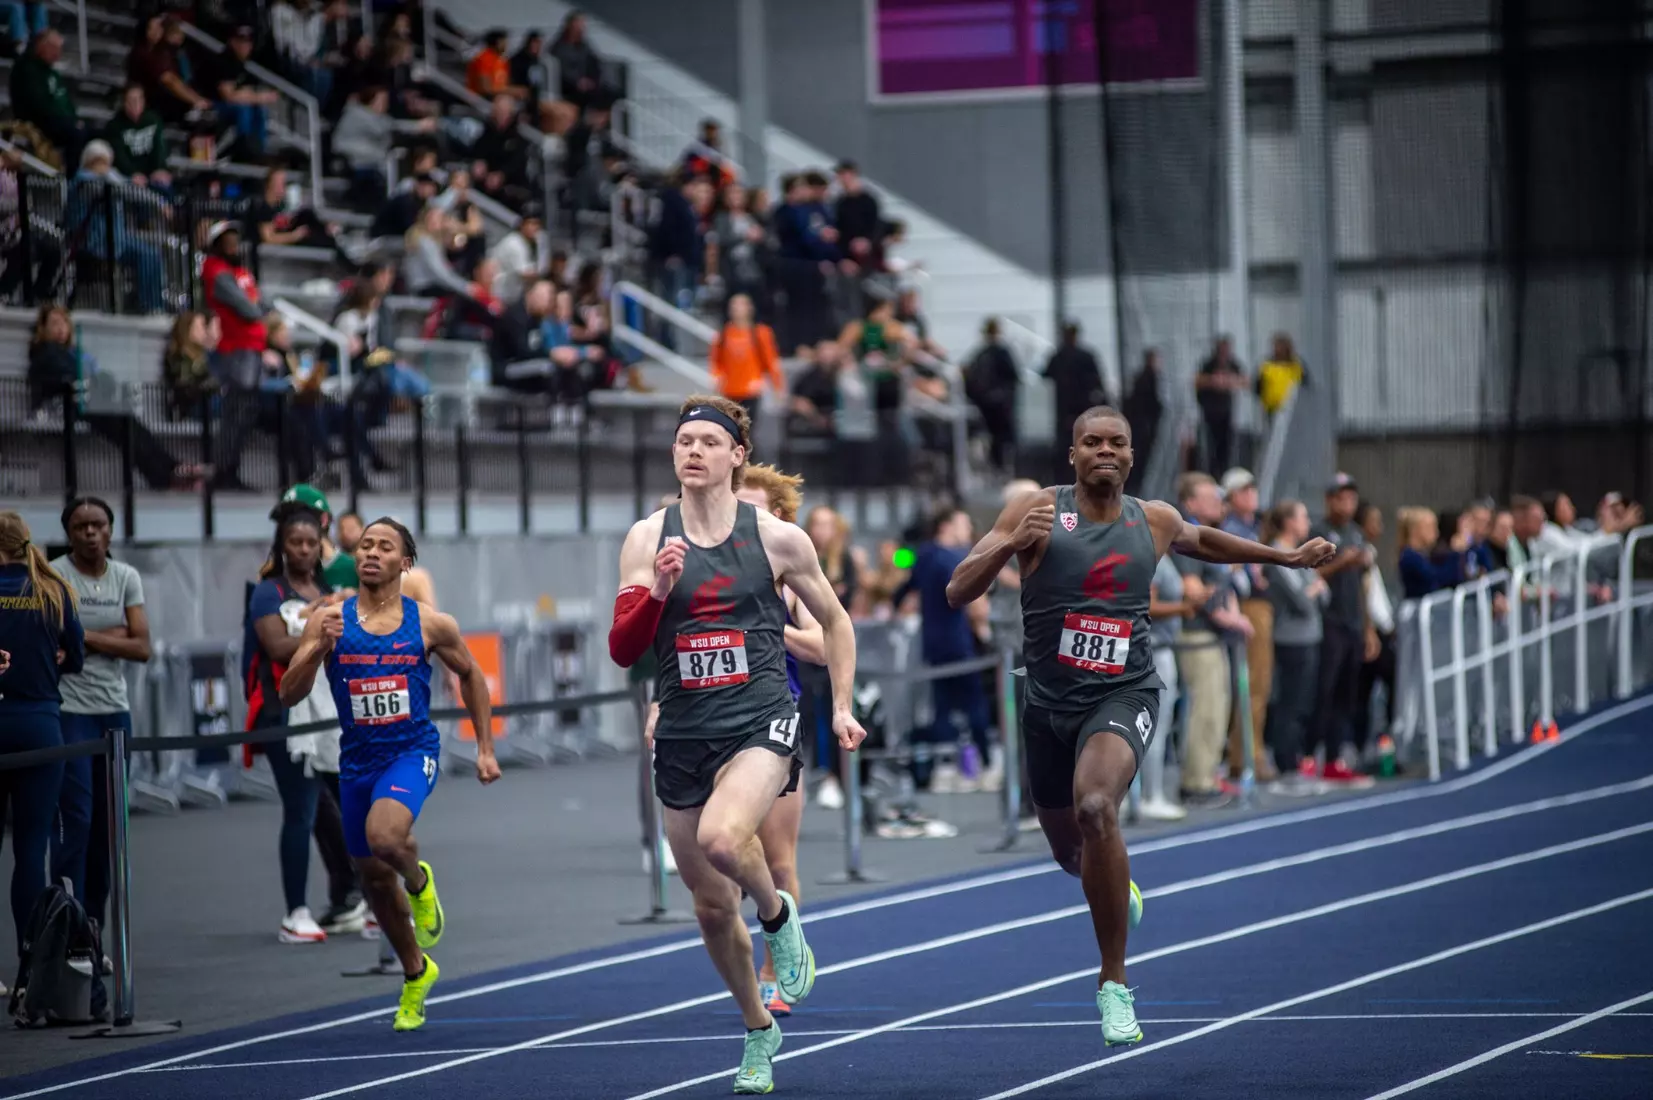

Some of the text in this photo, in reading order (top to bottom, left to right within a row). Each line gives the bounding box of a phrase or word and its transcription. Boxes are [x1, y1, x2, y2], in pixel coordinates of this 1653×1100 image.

[1080, 619, 1120, 633] WSU OPEN
[690, 635, 730, 648] WSU OPEN
[1071, 632, 1116, 663] 881
[689, 649, 736, 678] 879
[361, 680, 397, 692] WSU OPEN
[361, 692, 400, 717] 166
[775, 718, 791, 742] 4
